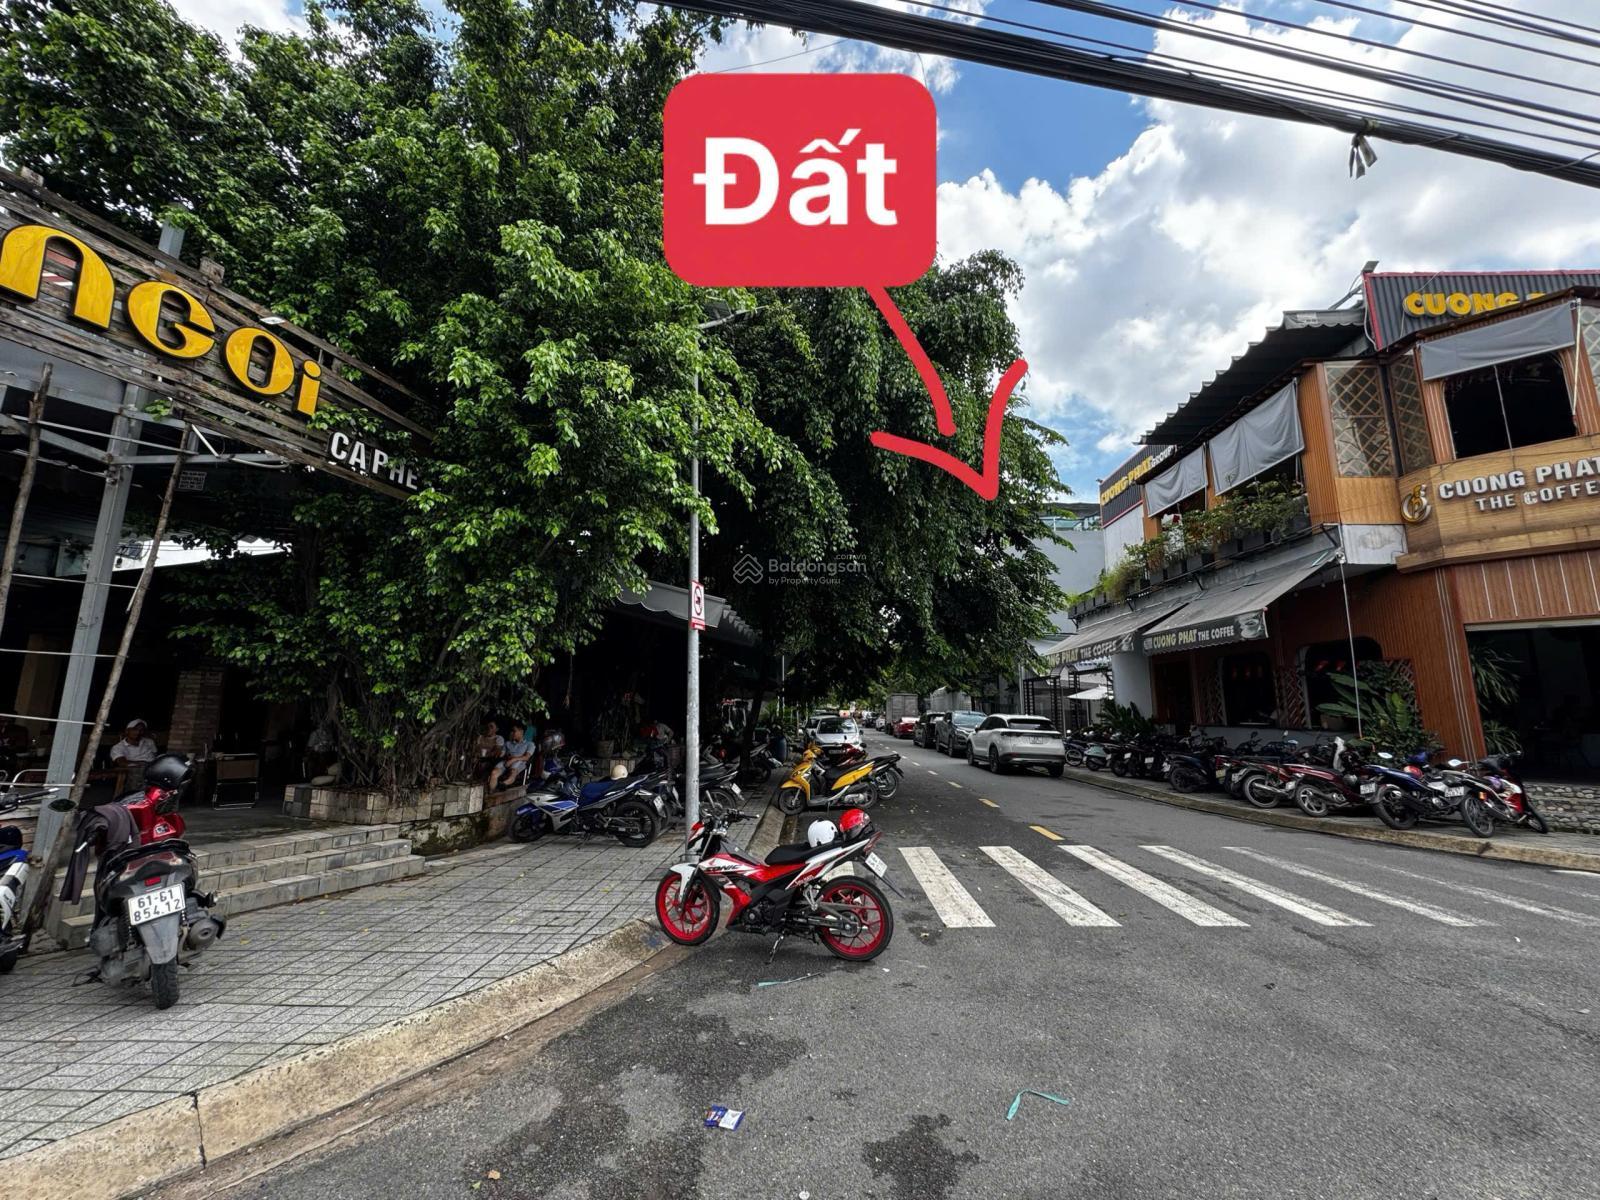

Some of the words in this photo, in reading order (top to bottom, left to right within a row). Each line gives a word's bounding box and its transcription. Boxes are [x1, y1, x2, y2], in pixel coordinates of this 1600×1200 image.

[1403, 292, 1521, 318] CUONG
[1438, 470, 1526, 499] CUONG
[1475, 494, 1517, 511] THE
[1153, 633, 1176, 649] CUONG
[1178, 628, 1197, 645] PHAT
[1198, 630, 1210, 641] THE
[1211, 625, 1234, 639] COFFEE
[133, 899, 181, 922] 854.12
